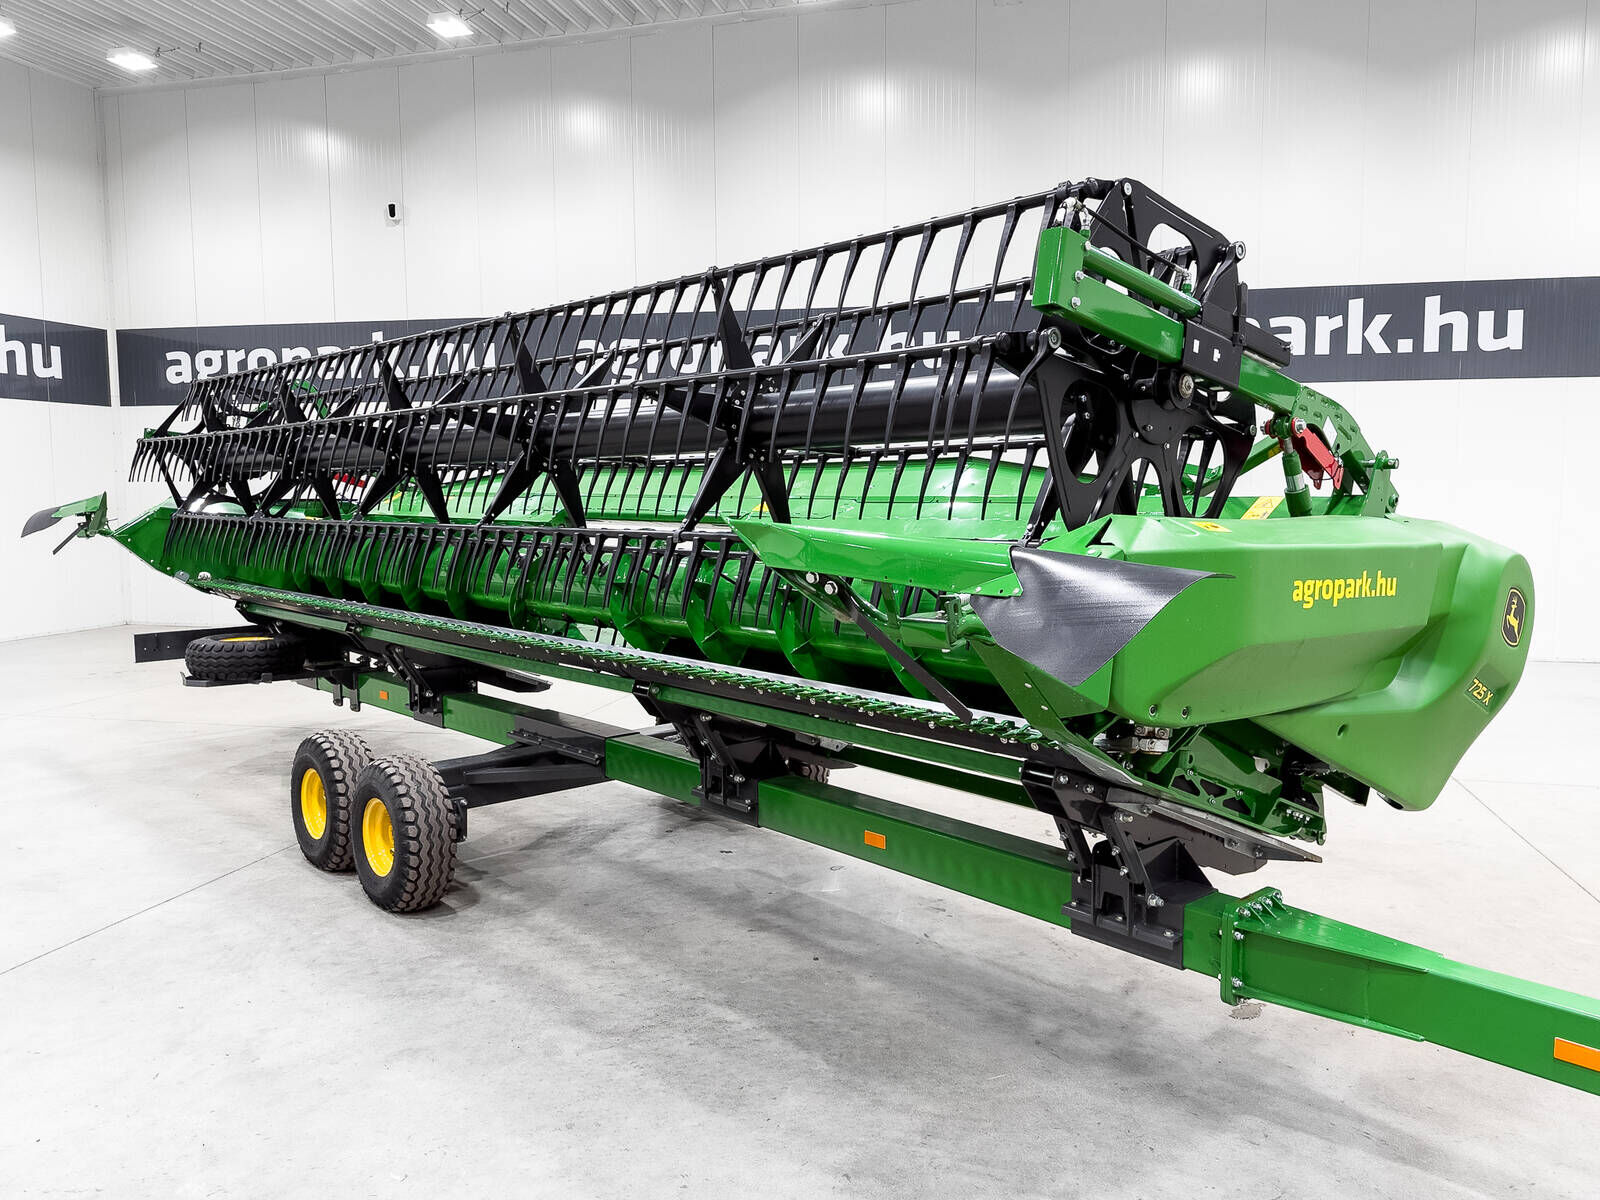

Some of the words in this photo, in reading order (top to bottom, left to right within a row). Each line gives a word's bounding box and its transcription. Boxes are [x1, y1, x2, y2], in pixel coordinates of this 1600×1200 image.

[574, 318, 960, 386] agroakhu
[1246, 294, 1524, 356] ark.hu
[1292, 570, 1397, 609] agropark.hu
